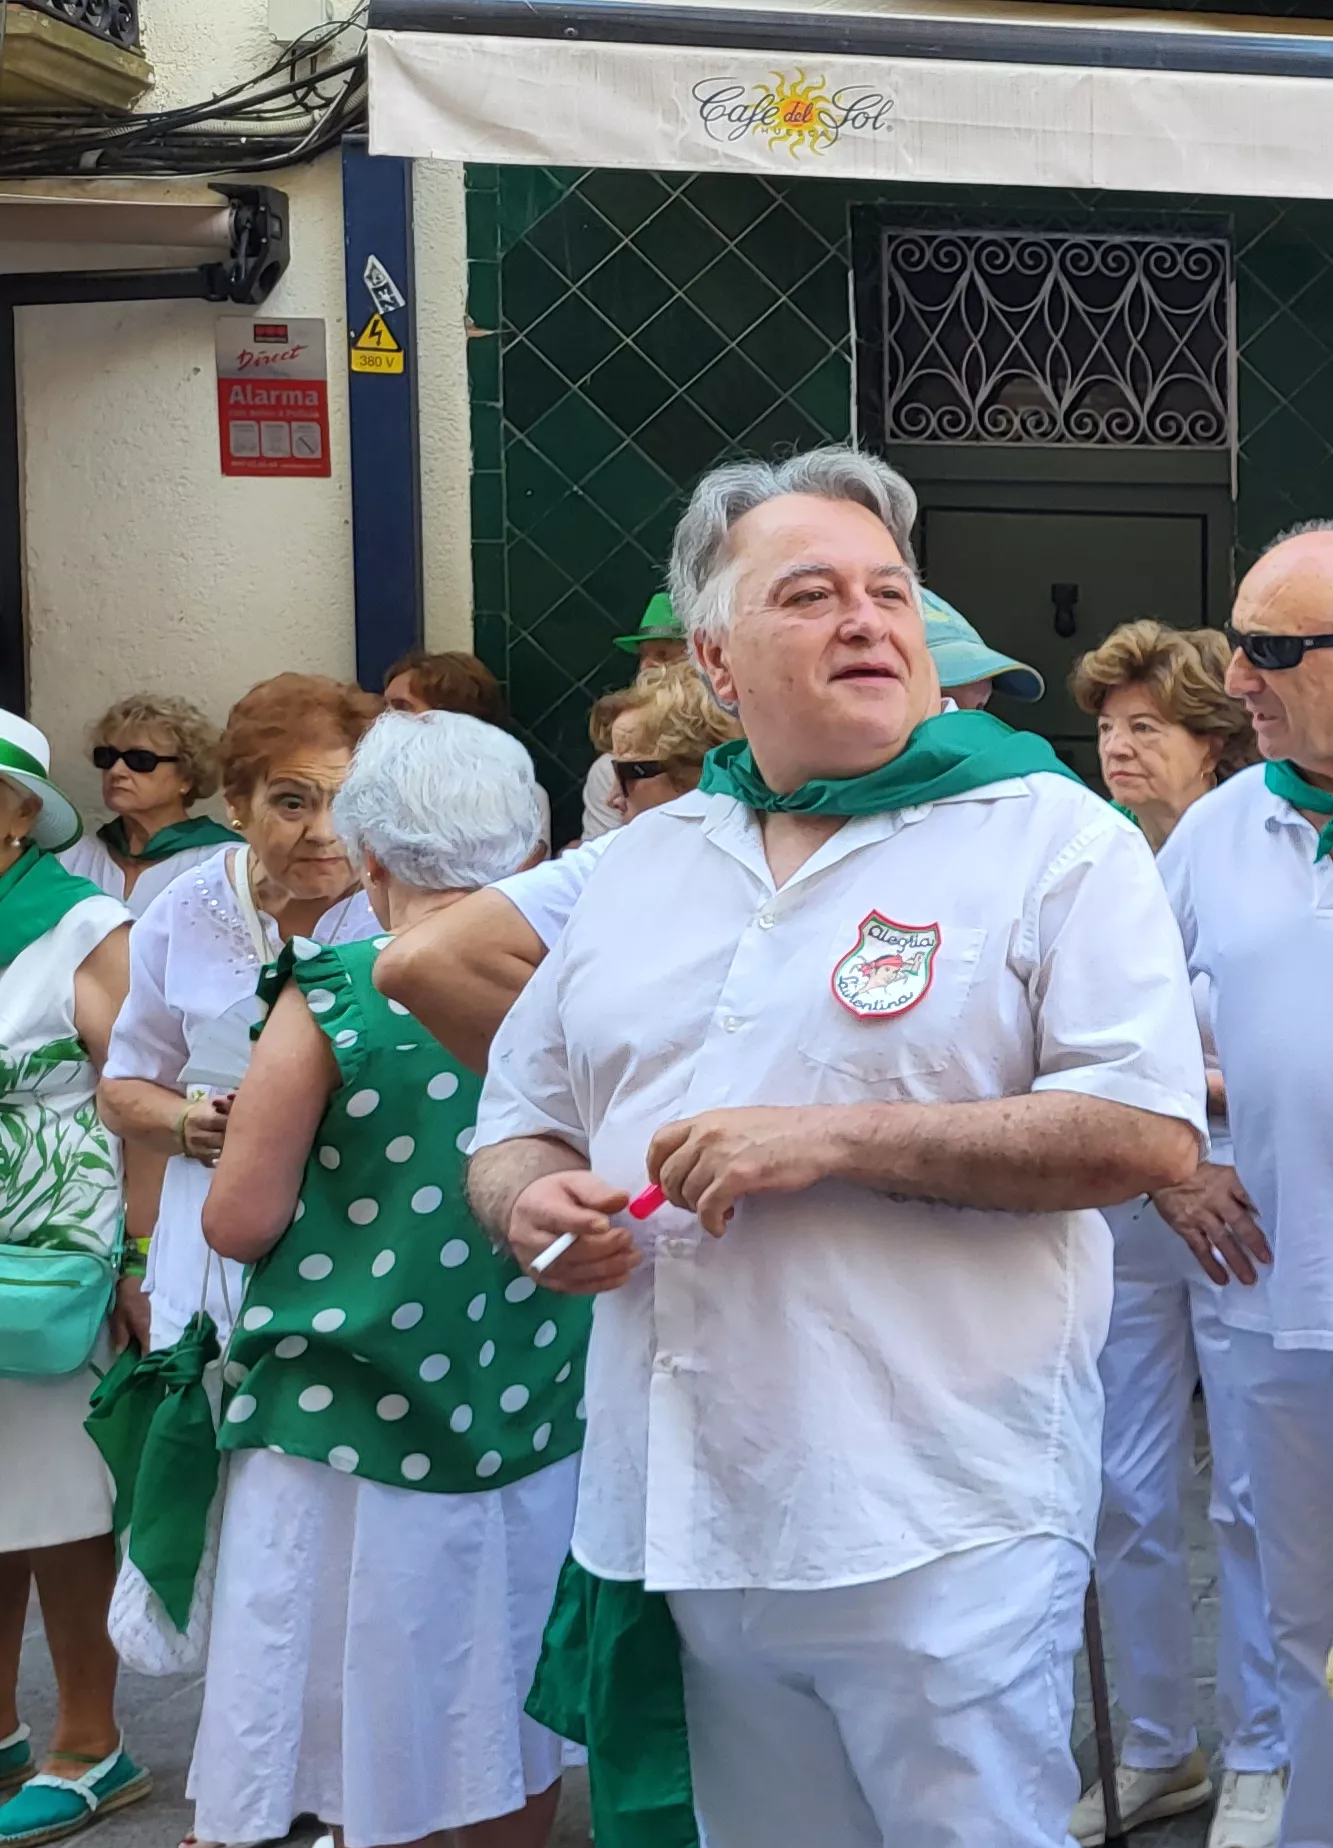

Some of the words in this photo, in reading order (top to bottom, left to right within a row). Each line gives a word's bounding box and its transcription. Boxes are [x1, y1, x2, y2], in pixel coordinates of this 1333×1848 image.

[783, 101, 814, 124] del
[359, 355, 382, 368] 380
[386, 356, 396, 368] V
[229, 384, 320, 407] Alarma
